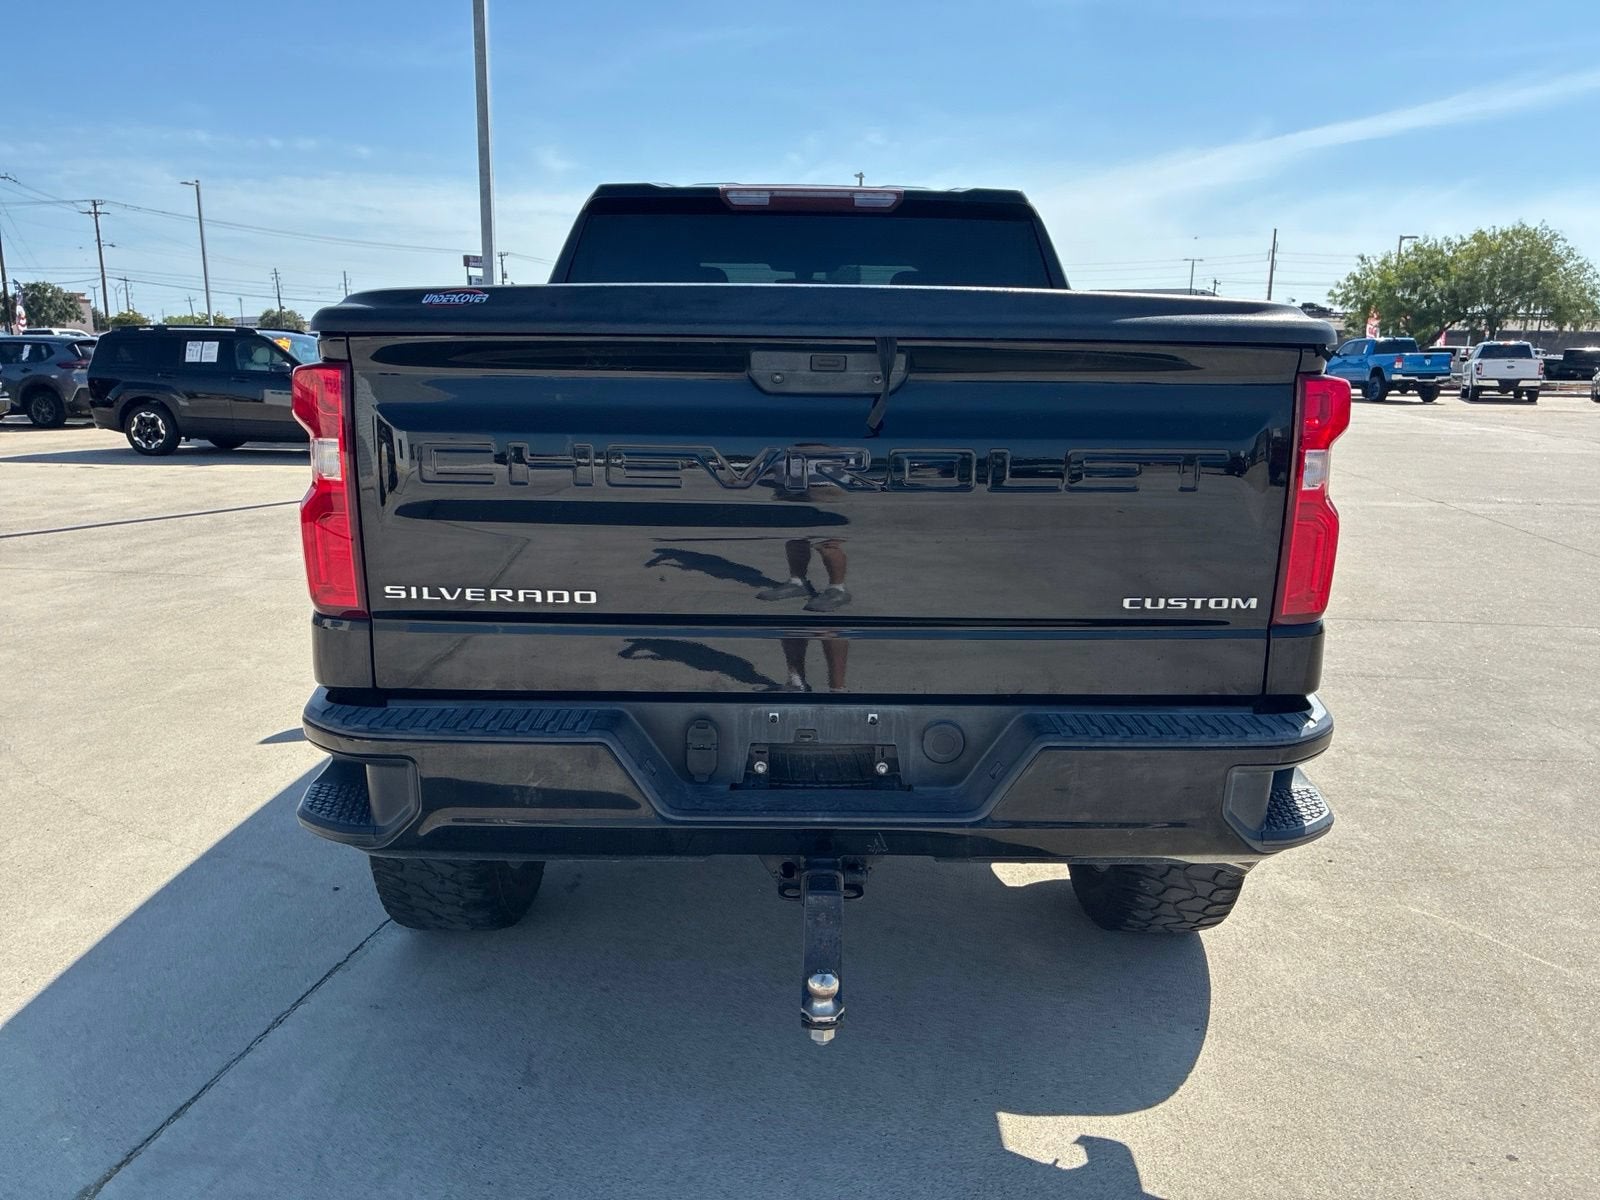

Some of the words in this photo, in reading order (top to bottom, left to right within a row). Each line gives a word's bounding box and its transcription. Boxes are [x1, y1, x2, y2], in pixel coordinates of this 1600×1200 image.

[421, 293, 490, 305] UNDERCOVER
[417, 442, 1231, 493] CHEVROLET
[384, 585, 597, 604] SILVERADO
[1122, 597, 1258, 609] CUSTOM
